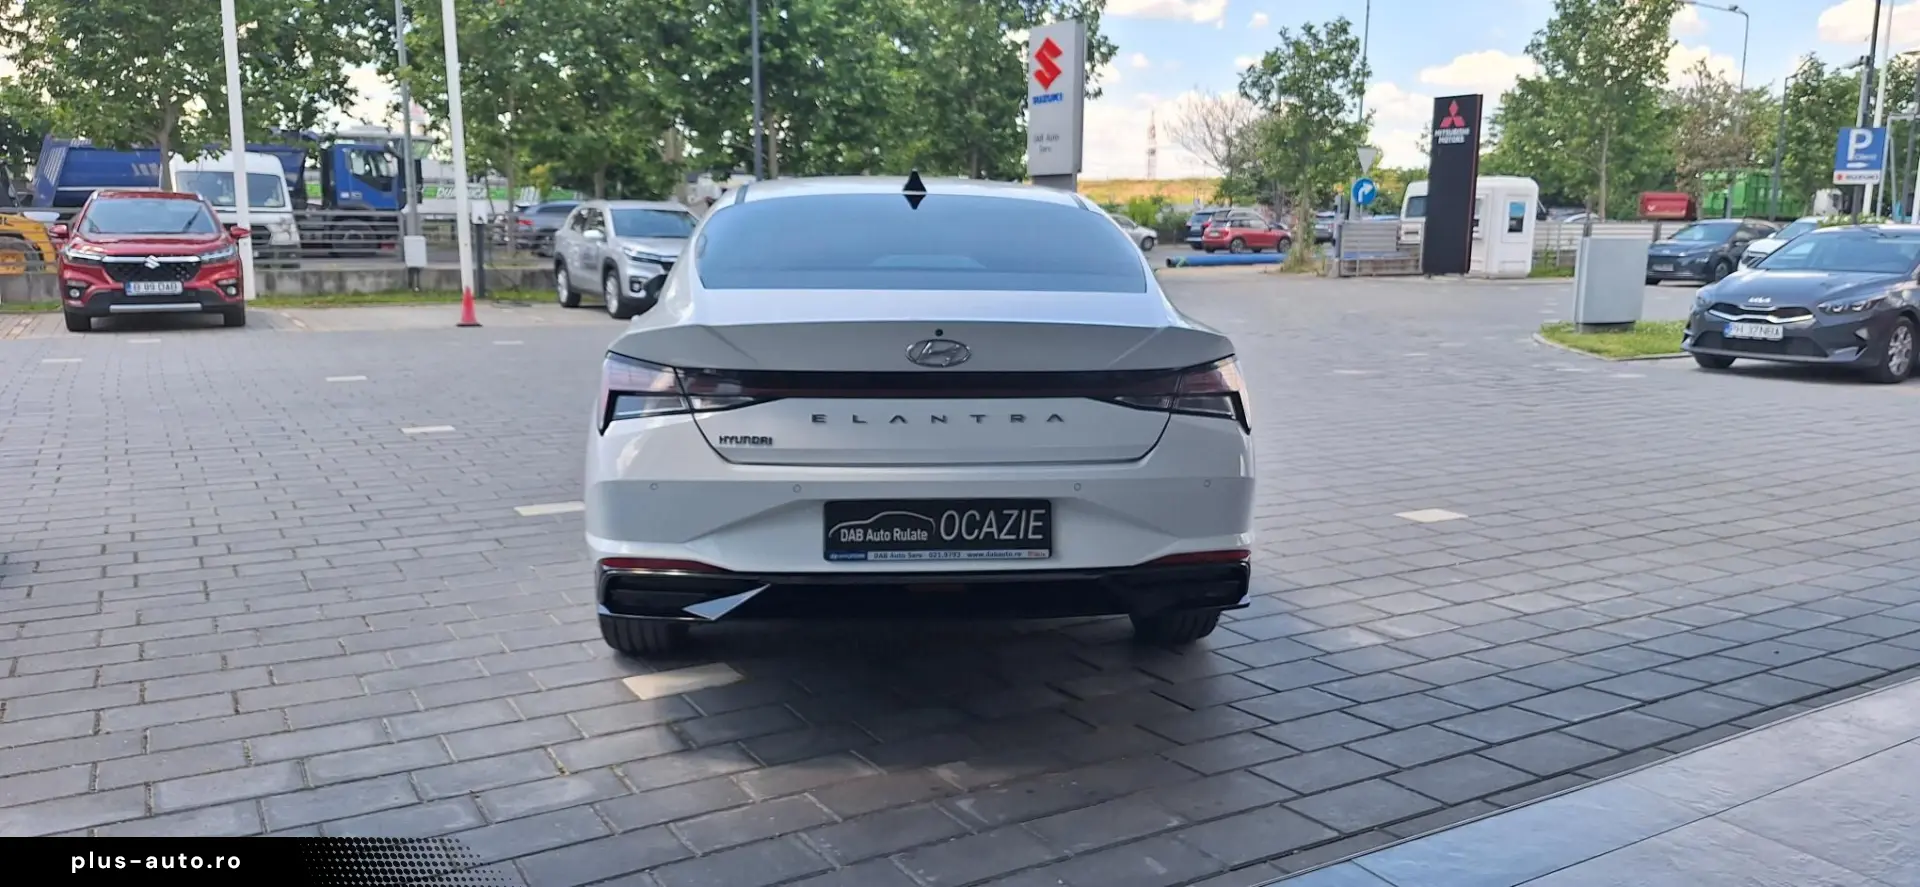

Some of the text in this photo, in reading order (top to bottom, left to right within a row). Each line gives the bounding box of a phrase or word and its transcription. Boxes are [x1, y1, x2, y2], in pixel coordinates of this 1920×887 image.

[1032, 92, 1063, 105] SUZUKI
[1437, 135, 1465, 144] MOTORS
[1847, 129, 1872, 161] P
[811, 413, 1065, 424] ELANTRA
[719, 435, 773, 445] HYUNDAI
[940, 509, 1046, 541] OCAZIE
[840, 527, 928, 542] DAB Auto Rulate
